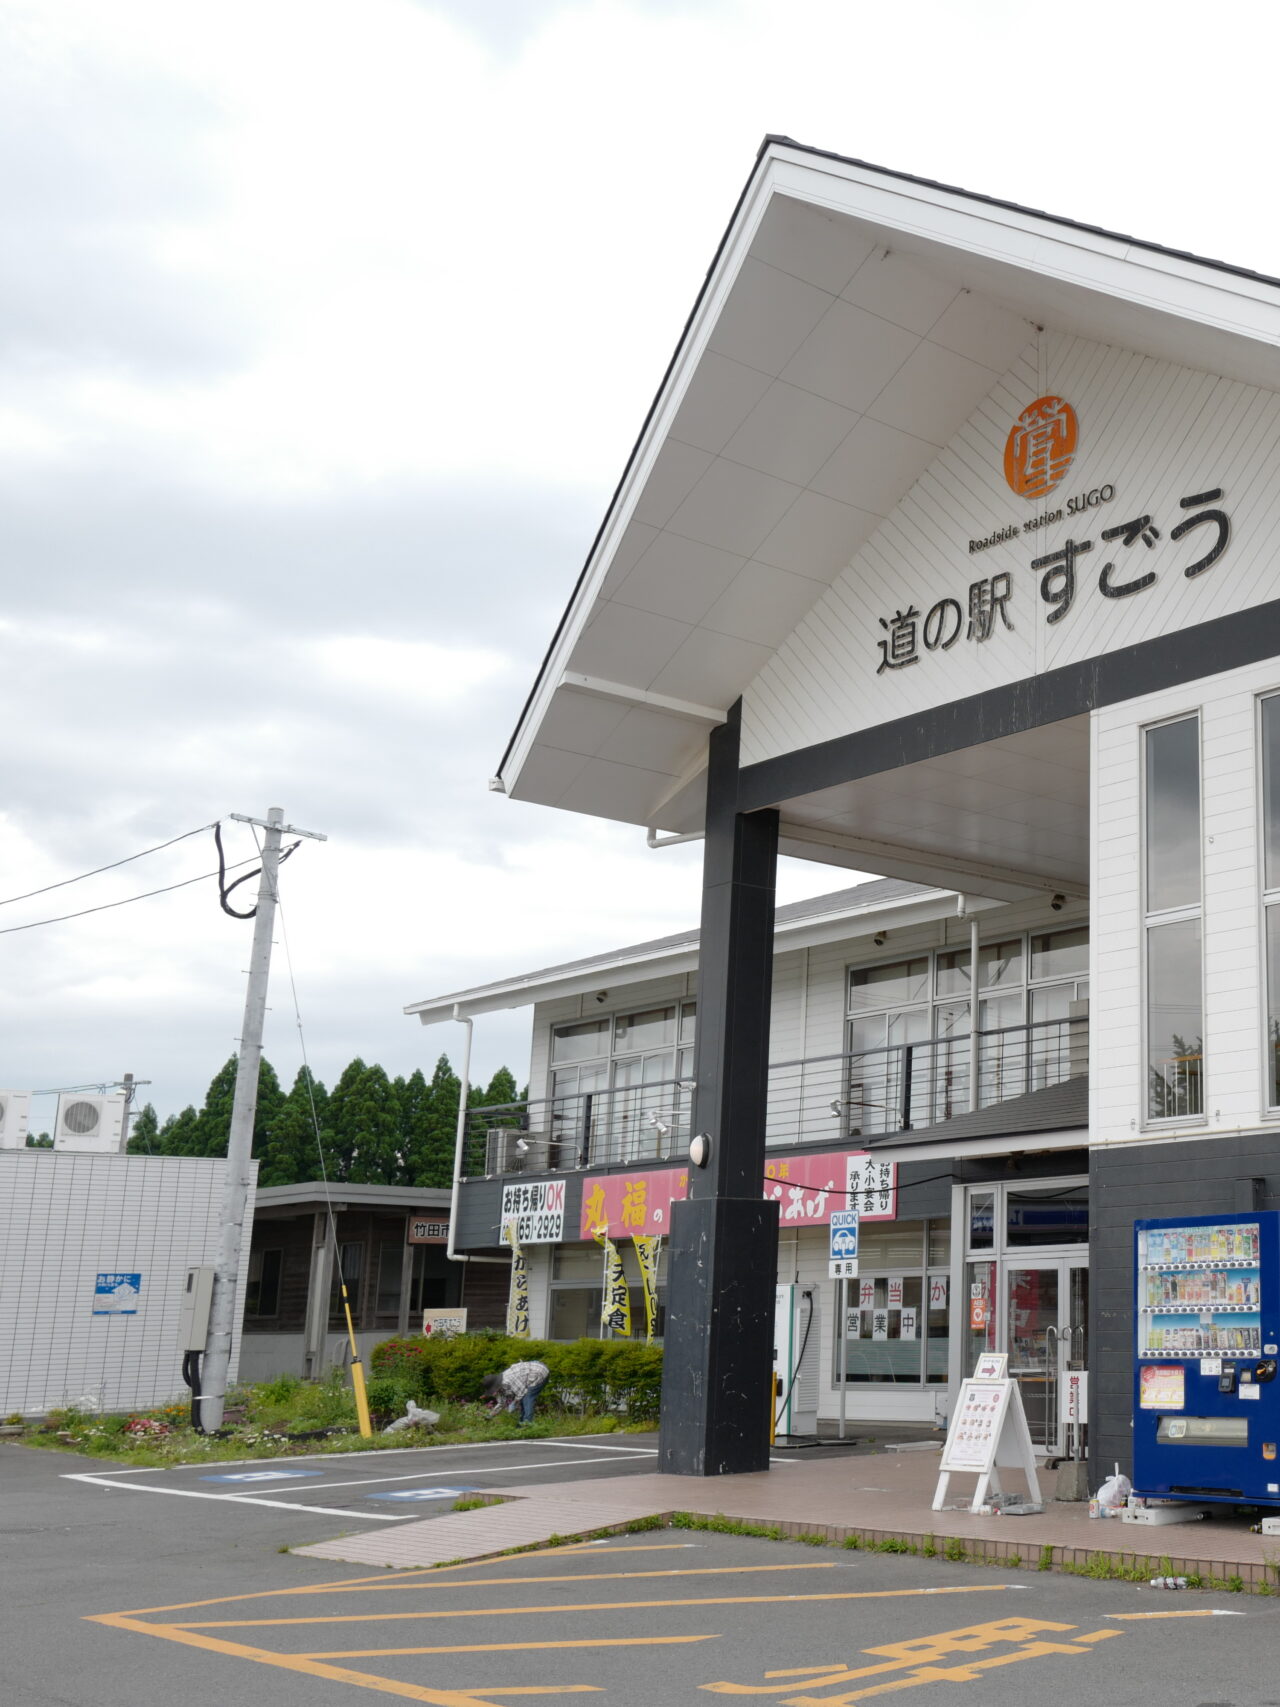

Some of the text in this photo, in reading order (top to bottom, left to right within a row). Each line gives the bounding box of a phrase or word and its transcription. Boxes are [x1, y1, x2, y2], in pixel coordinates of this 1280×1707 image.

[968, 483, 1116, 554] Roadside station SUGO
[831, 1213, 857, 1227] QUICK
[834, 1262, 853, 1276] 専用
[847, 1311, 914, 1334] 営業中
